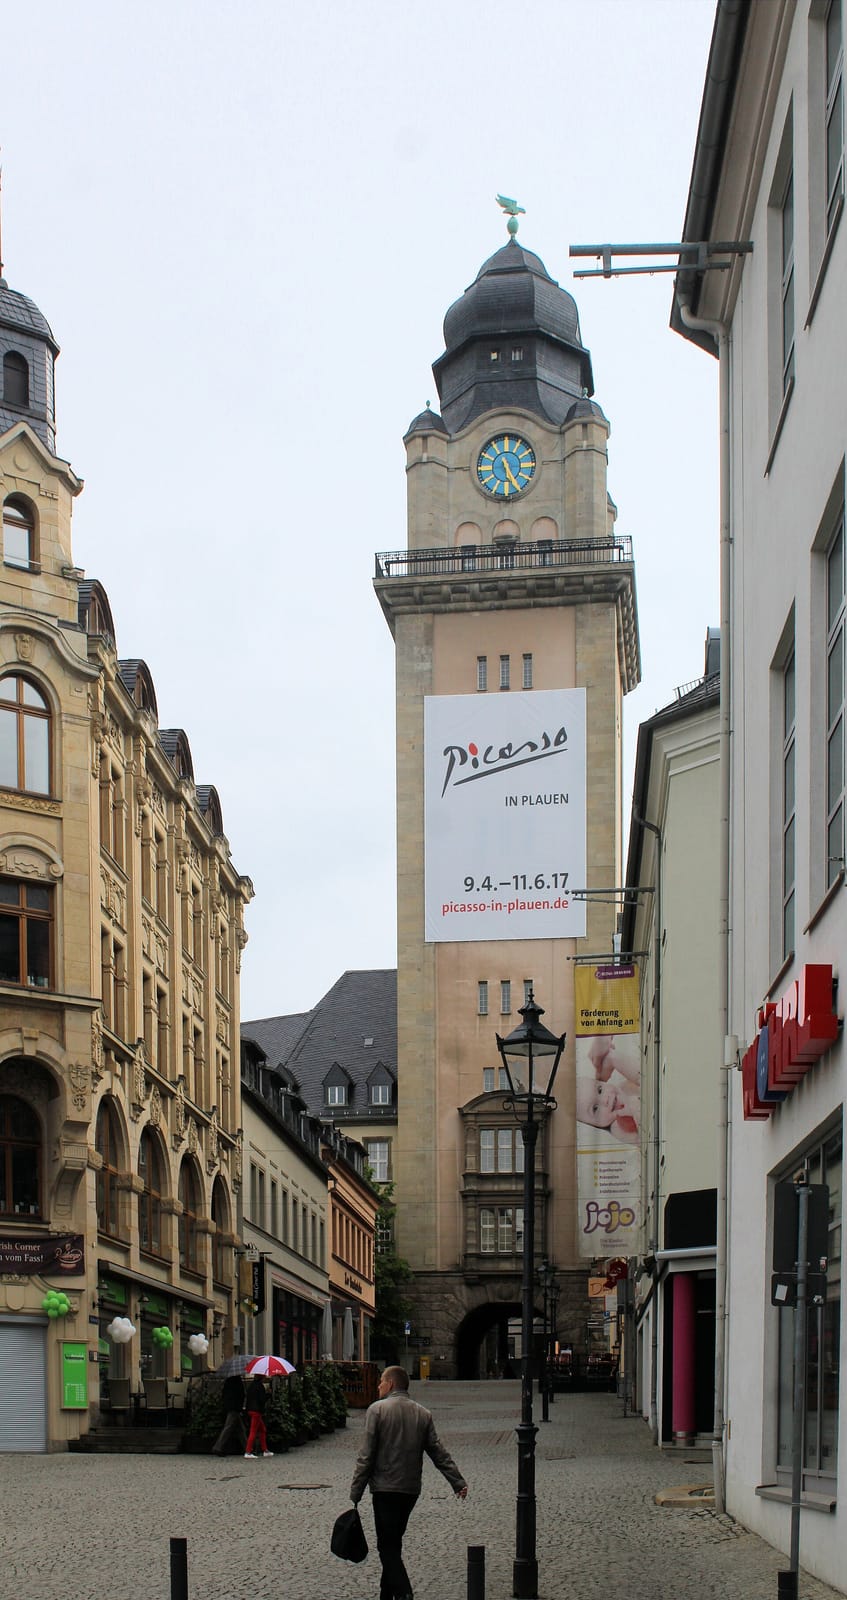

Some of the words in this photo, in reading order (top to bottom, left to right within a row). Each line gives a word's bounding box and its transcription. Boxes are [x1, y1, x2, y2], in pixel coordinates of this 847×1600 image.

[441, 726, 569, 798] Picasso
[505, 795, 518, 807] IN
[521, 793, 569, 806] PLAUEN
[442, 898, 569, 916] picasso-in-plauen.de
[581, 1010, 618, 1018] Förderung
[597, 1019, 622, 1027] Anfang
[583, 1201, 635, 1233] jojo
[14, 1242, 41, 1251] Corner
[24, 1254, 43, 1263] Fass!
